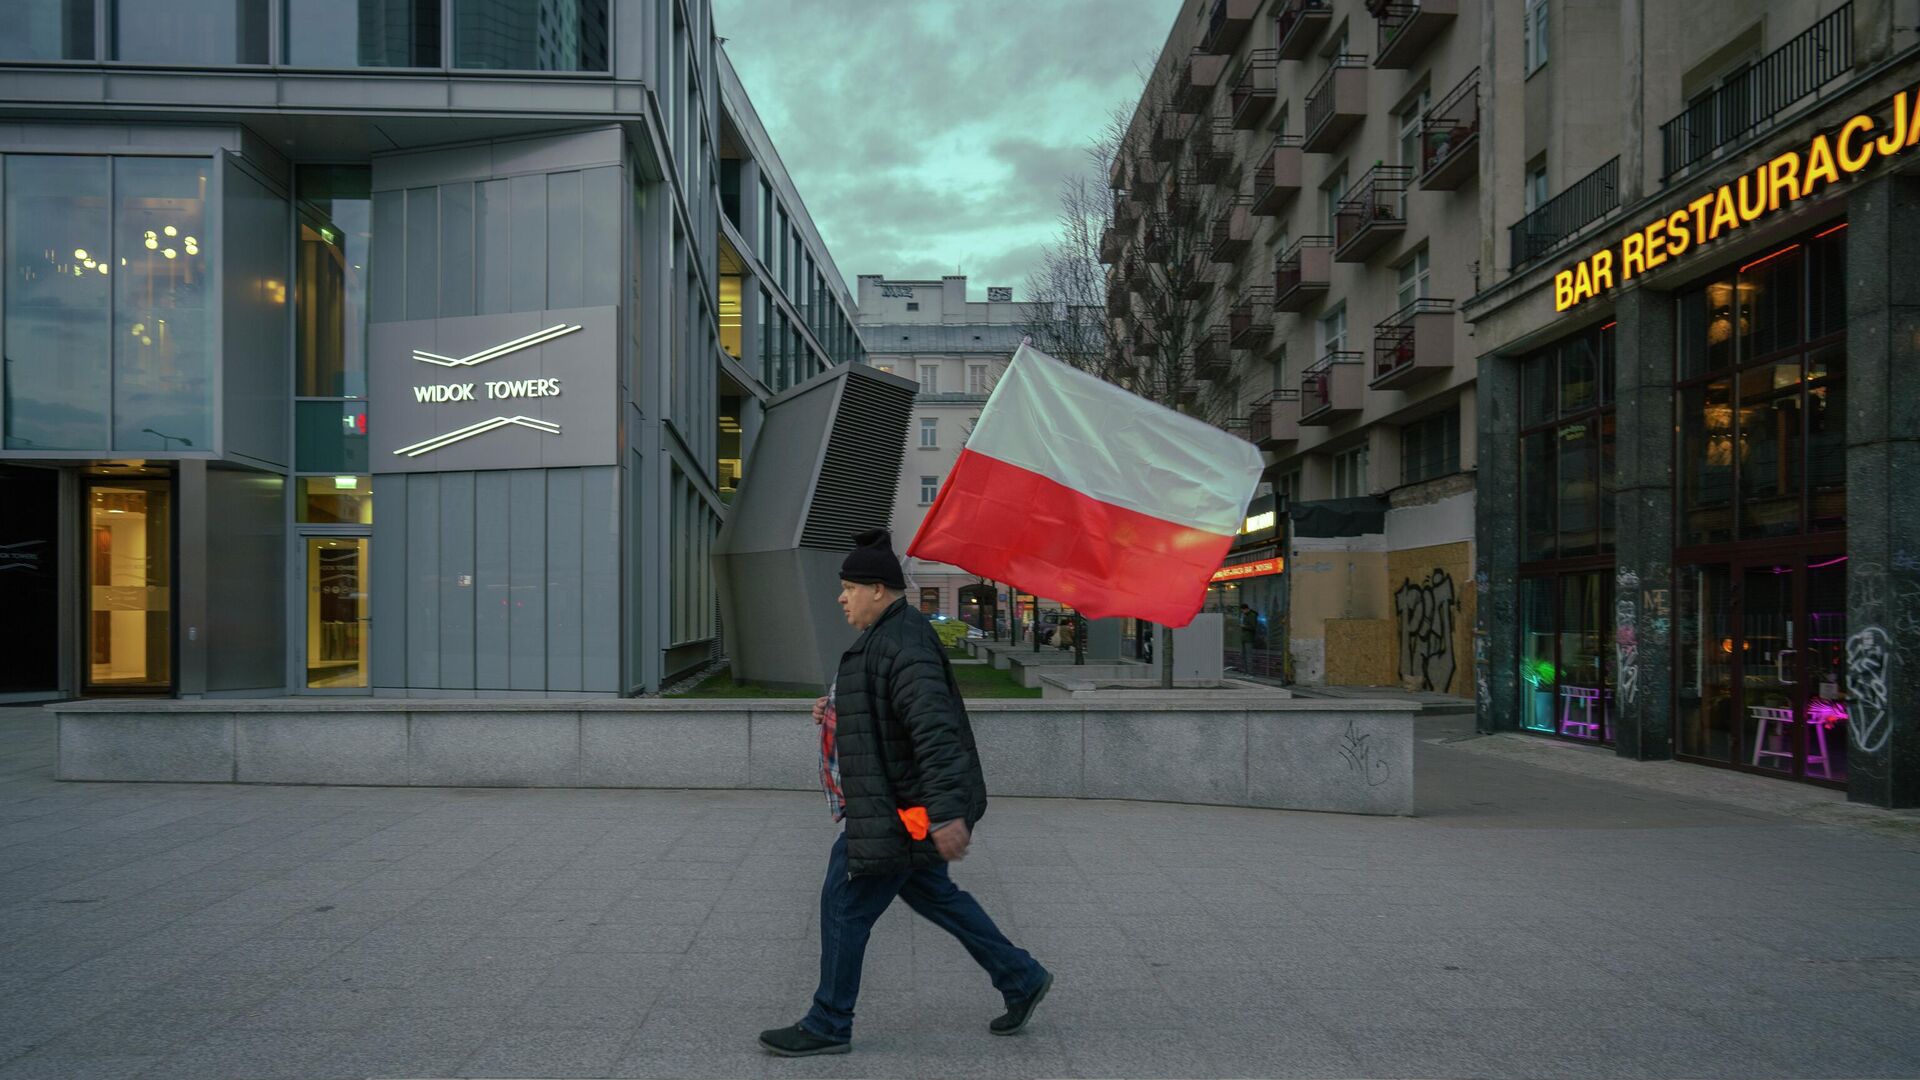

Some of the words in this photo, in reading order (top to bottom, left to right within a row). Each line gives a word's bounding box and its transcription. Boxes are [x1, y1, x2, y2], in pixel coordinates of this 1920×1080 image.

[1555, 249, 1614, 312] BAR
[413, 383, 475, 402] WIDOK
[484, 377, 561, 399] TOWERS
